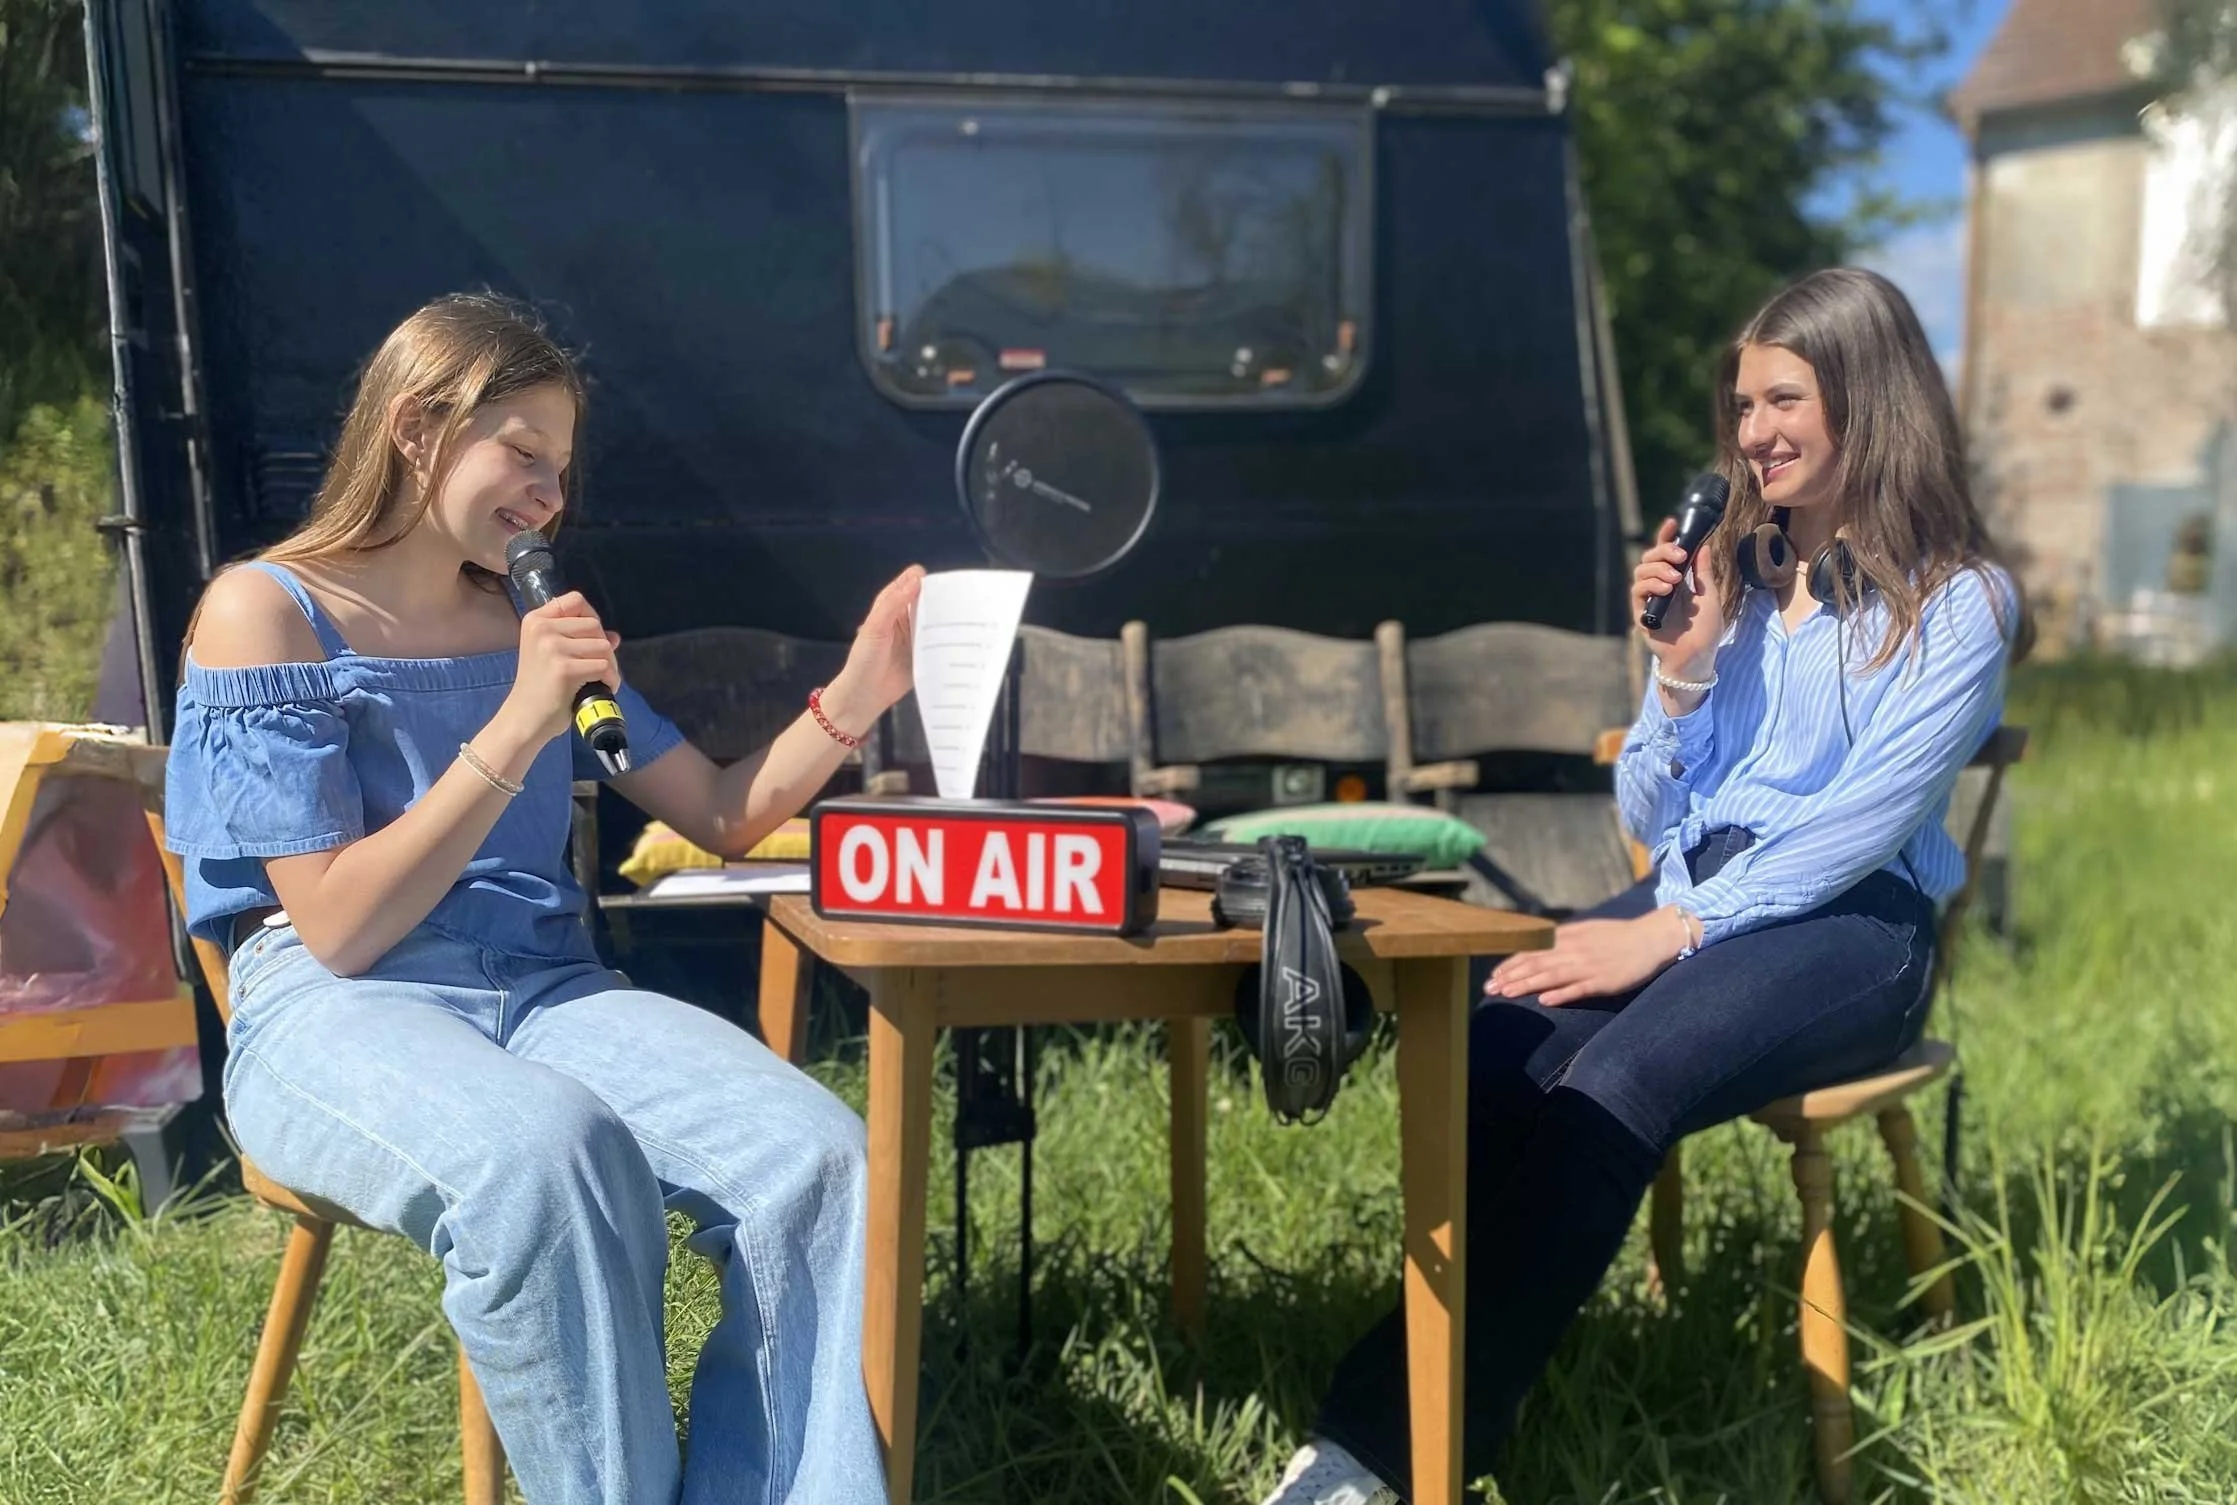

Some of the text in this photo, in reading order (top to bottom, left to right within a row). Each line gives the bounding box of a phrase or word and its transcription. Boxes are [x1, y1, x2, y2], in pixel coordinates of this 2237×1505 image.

[838, 824, 1104, 914] ON AIR
[1282, 965, 1322, 1087] AKG
